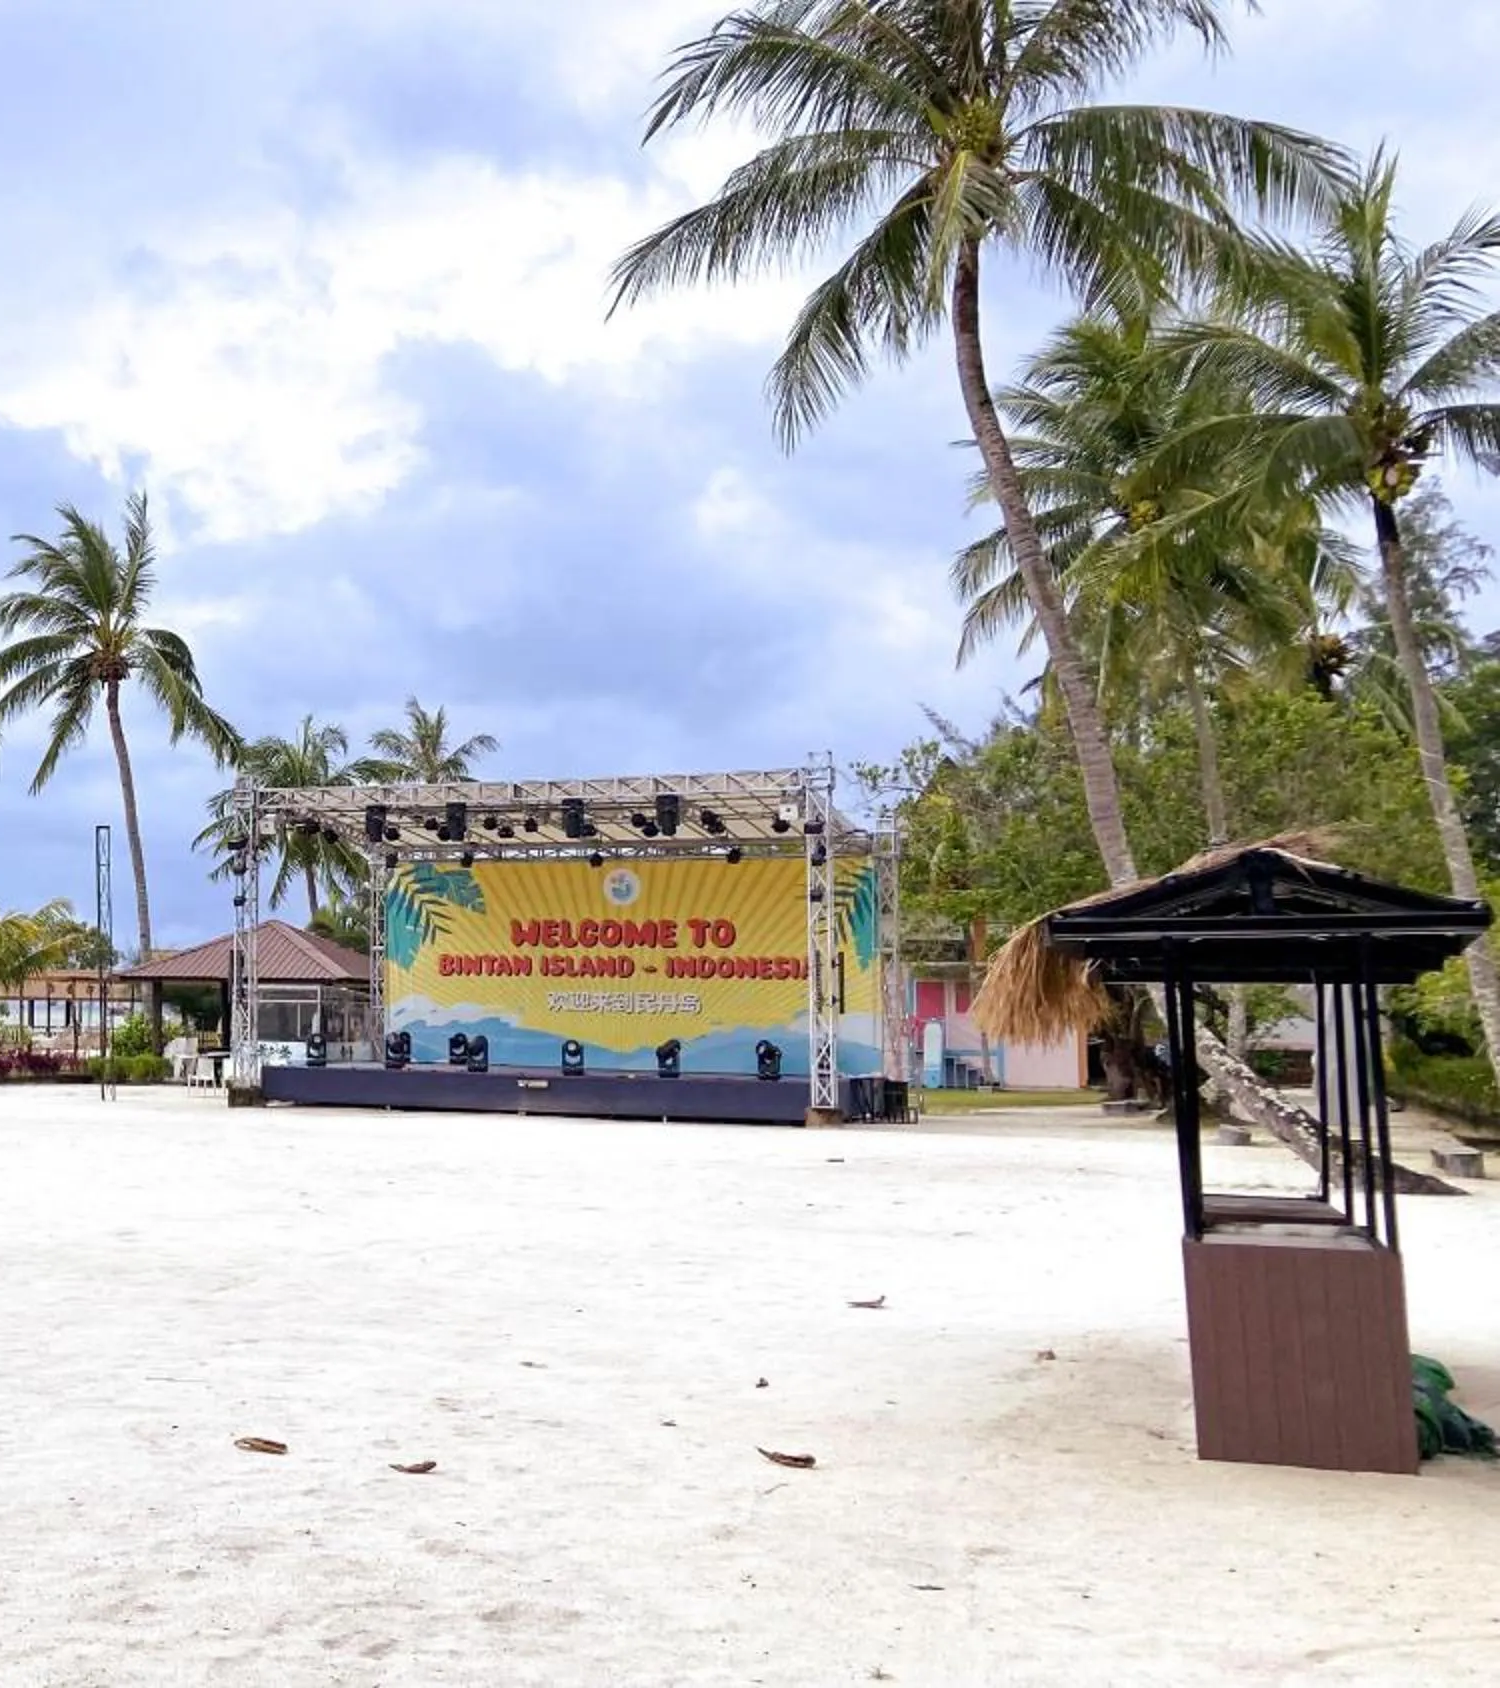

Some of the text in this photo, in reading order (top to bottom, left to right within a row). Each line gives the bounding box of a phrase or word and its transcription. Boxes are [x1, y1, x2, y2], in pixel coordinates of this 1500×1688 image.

[510, 917, 736, 948] WELCOME TO
[438, 954, 533, 977] BINTAN
[539, 955, 635, 978] ISLAND
